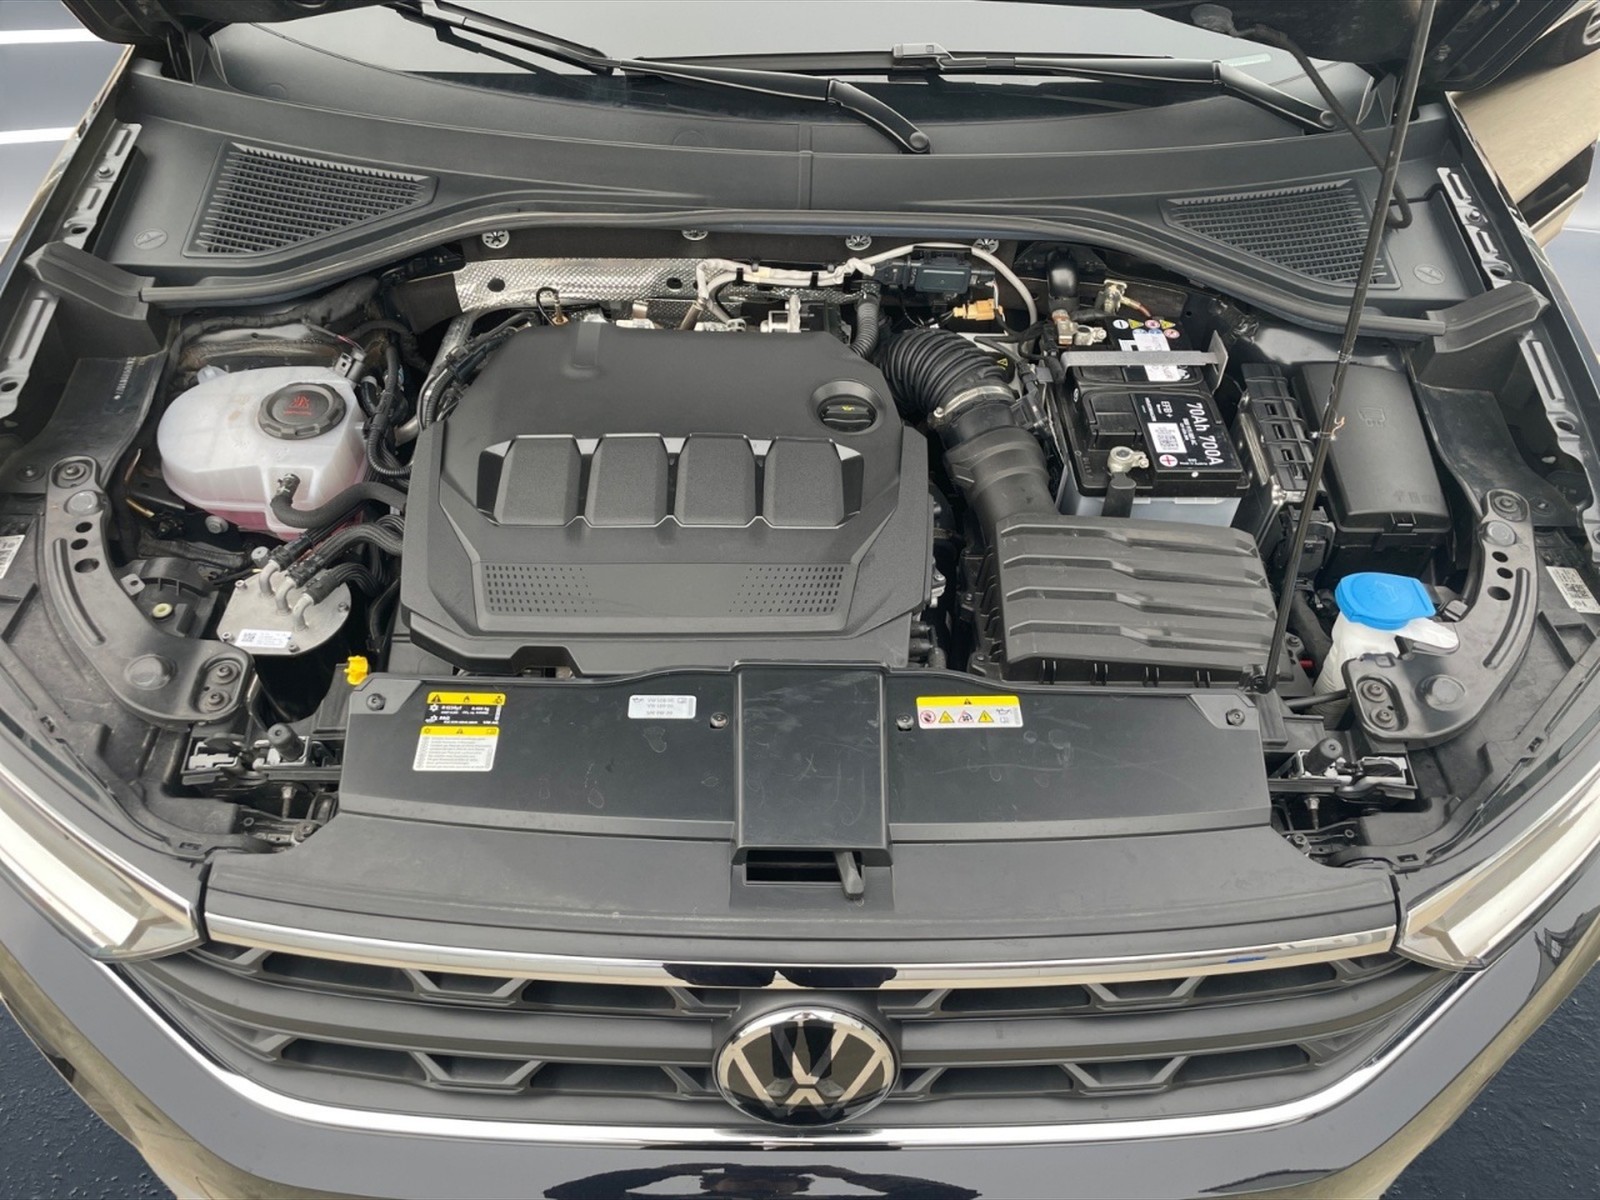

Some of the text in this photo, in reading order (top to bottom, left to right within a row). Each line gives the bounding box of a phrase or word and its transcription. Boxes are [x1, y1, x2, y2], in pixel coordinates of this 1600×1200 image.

[1186, 402, 1211, 432] 70Ah
[1198, 435, 1224, 466] 700A
[719, 1012, 894, 1125] VW
